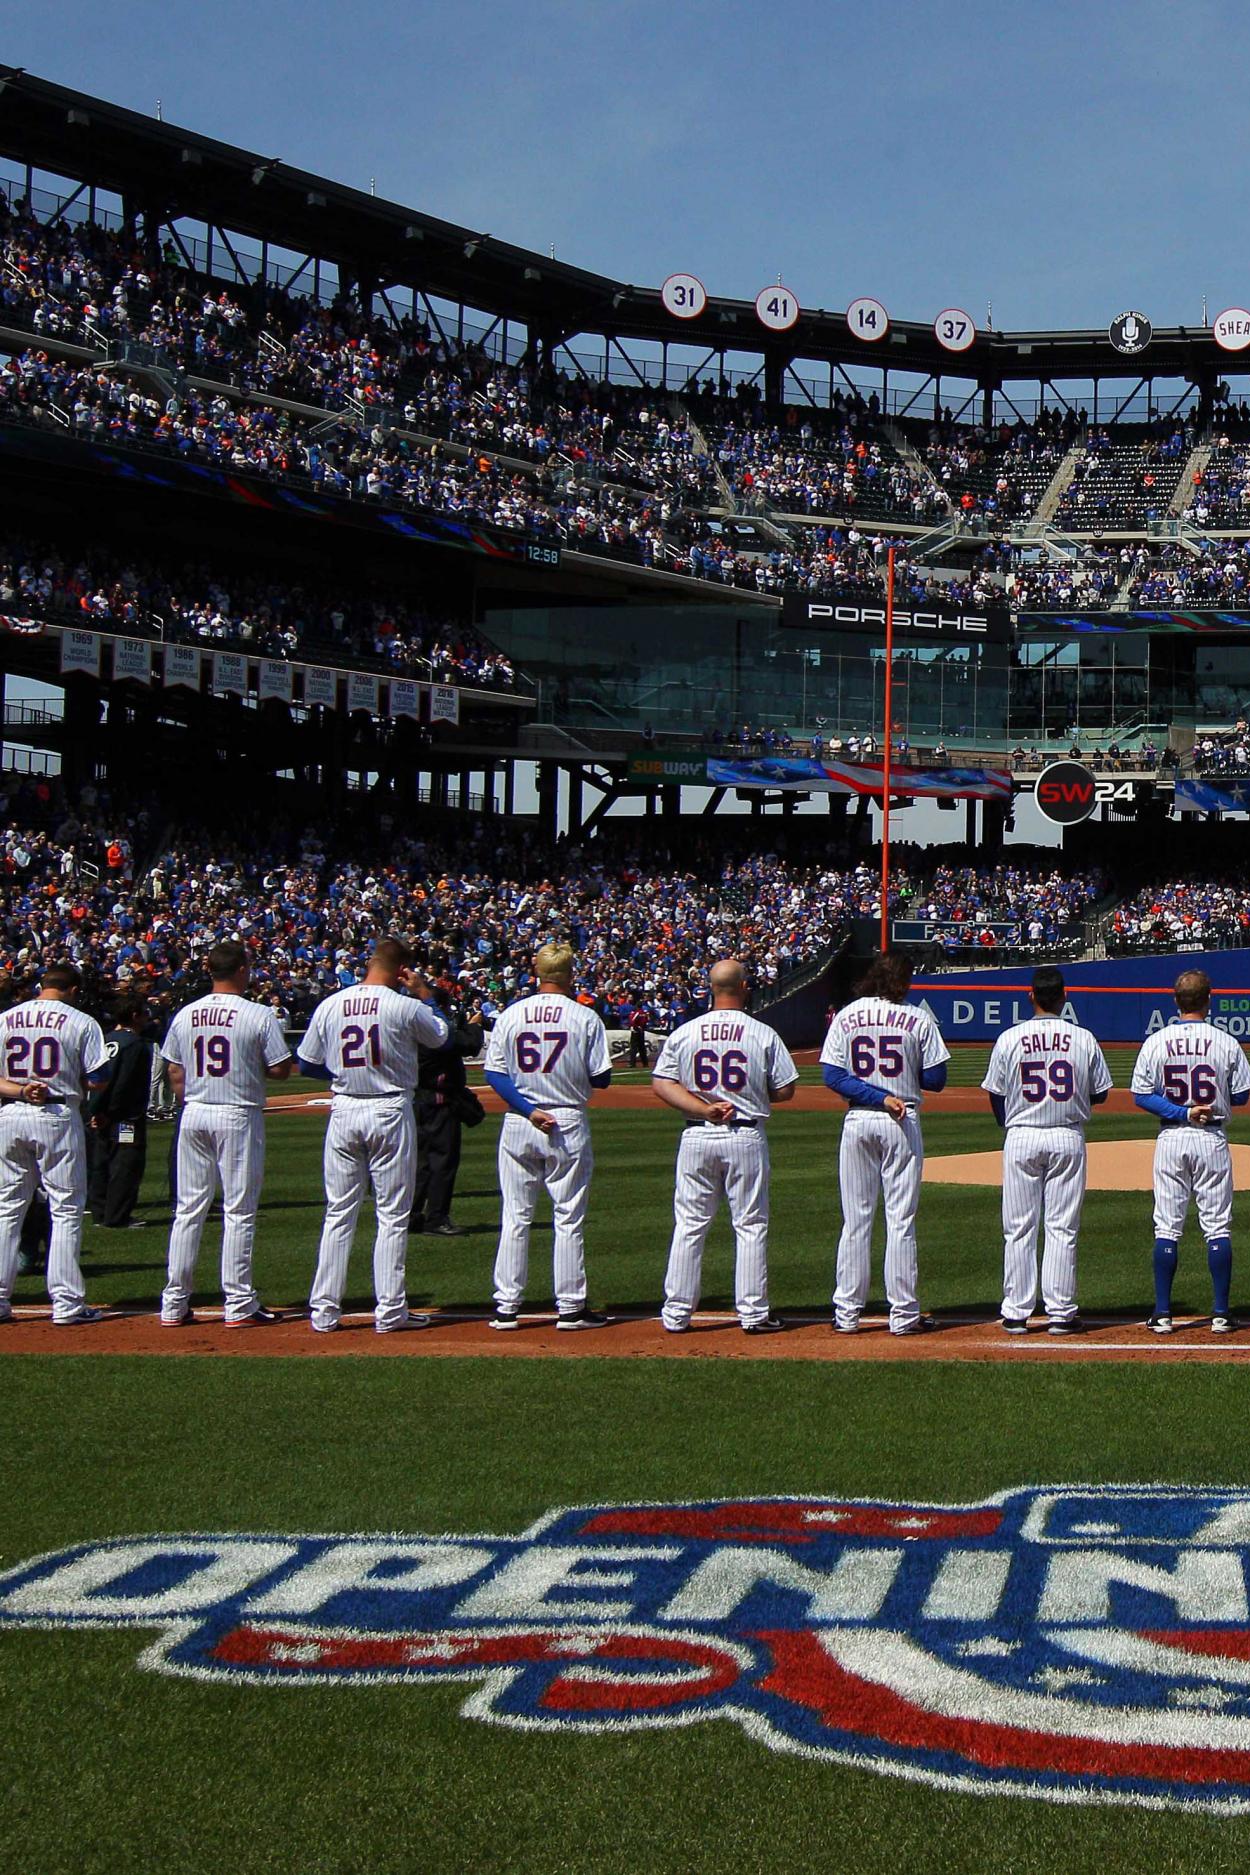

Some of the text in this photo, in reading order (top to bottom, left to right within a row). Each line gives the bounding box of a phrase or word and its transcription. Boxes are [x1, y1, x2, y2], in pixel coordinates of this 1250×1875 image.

[673, 286, 695, 307] 31
[767, 297, 788, 318] 41
[858, 308, 877, 329] 14
[1219, 320, 1250, 336] SHEA
[943, 320, 966, 340] 37
[528, 546, 558, 564] 12:58
[808, 604, 988, 632] PORSCHE
[72, 632, 92, 645] 1969
[124, 640, 144, 653] 1973
[174, 648, 193, 660] 1986
[222, 656, 241, 667] 1988
[268, 663, 286, 674] 1999
[311, 668, 330, 680] 2000
[397, 682, 414, 693] 2015
[437, 688, 454, 698] 2016
[632, 760, 704, 776] SUBWAY
[344, 998, 380, 1017] DUDA
[524, 1006, 563, 1024] LUGO
[953, 1001, 1078, 1025] DELA
[6, 1012, 68, 1031] WALKER
[192, 1009, 238, 1028] BRUCE
[840, 1009, 918, 1034] GSELLMAN
[701, 1024, 744, 1042] EDGIN
[340, 1024, 381, 1068] 21
[516, 1032, 568, 1074] 67
[1021, 1033, 1072, 1054] SALAS
[1165, 1039, 1212, 1058] KELLY
[6, 1036, 60, 1078] 20
[194, 1036, 231, 1078] 19
[851, 1035, 904, 1078] 65
[694, 1049, 748, 1092] 66
[1020, 1060, 1076, 1102] 59
[1164, 1064, 1216, 1106] 56
